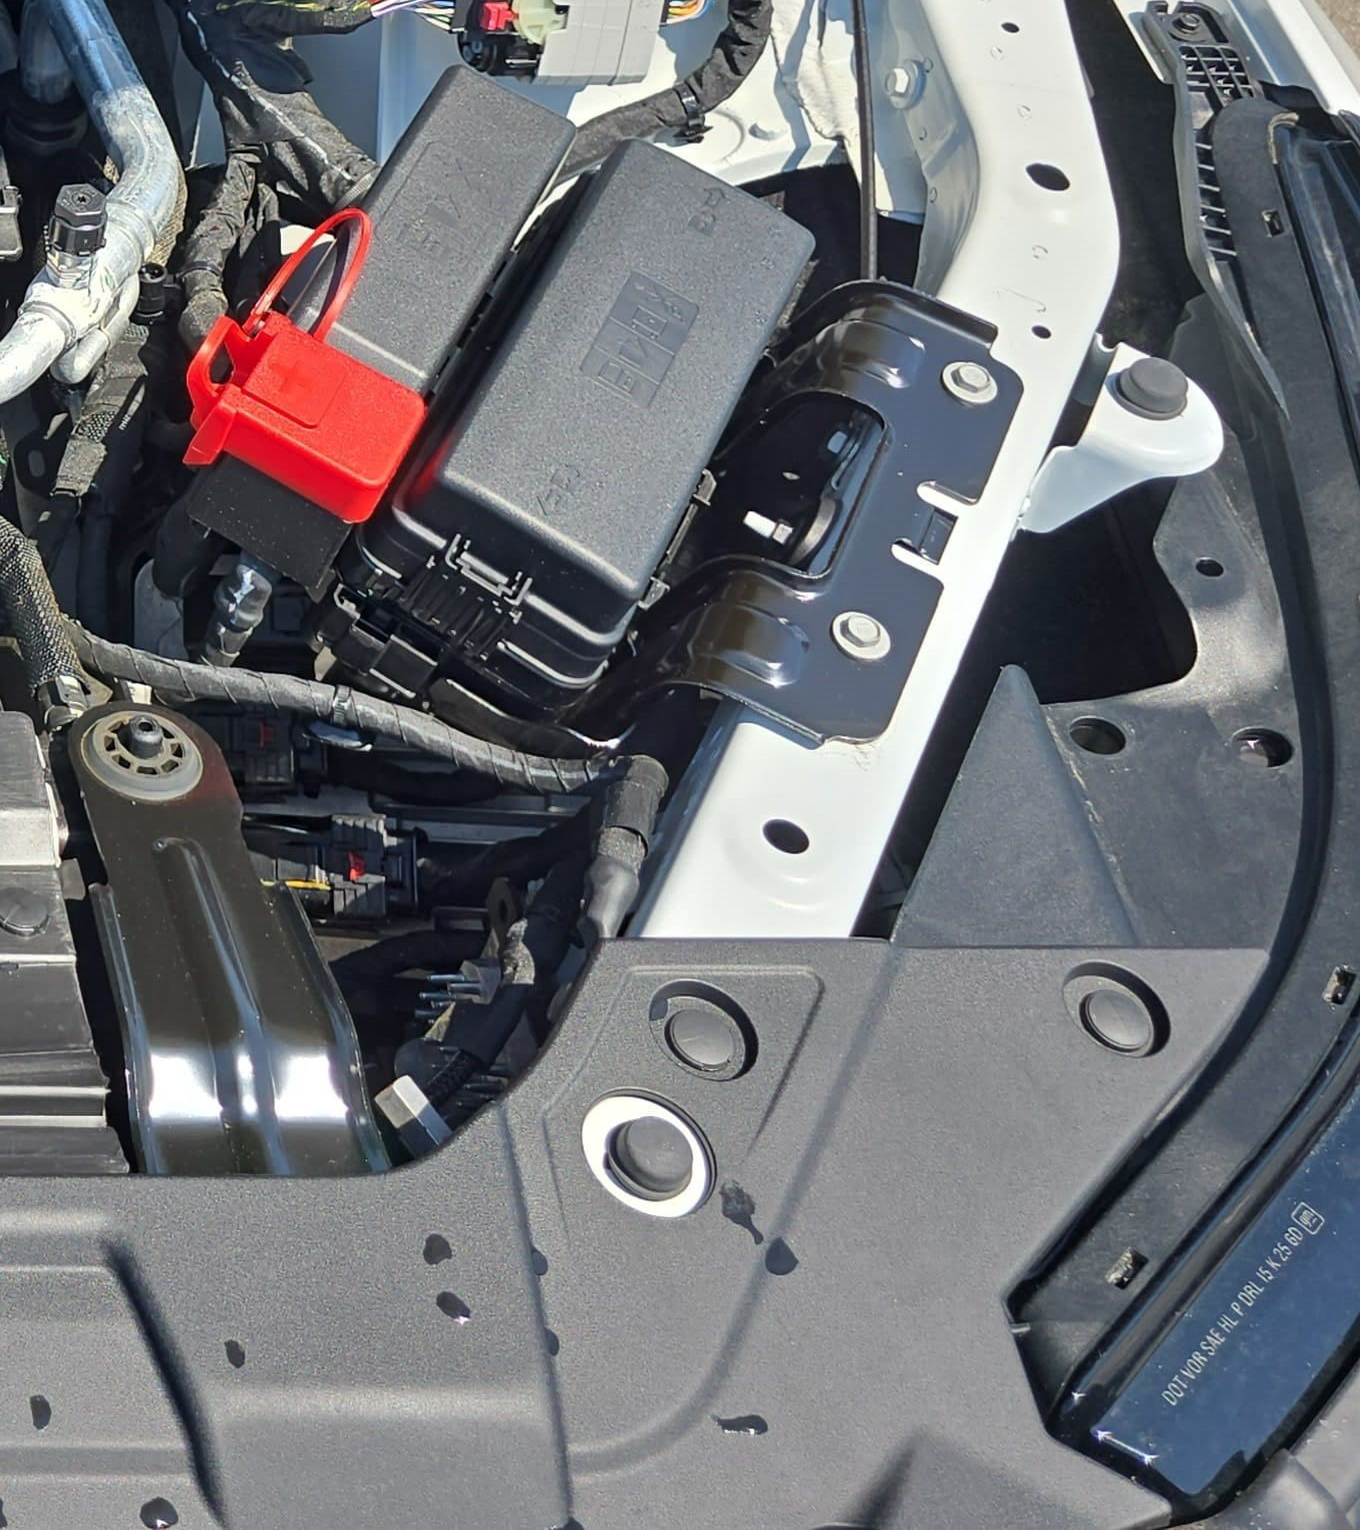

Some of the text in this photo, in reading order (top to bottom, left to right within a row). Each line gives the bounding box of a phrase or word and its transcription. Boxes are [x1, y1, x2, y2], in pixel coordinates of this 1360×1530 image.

[1265, 1255, 1282, 1271] K
[1273, 1243, 1293, 1263] 25
[1238, 1280, 1265, 1307] DRL
[1231, 1301, 1246, 1318] P
[1216, 1313, 1239, 1335] HL
[1199, 1327, 1226, 1357] SAE
[1179, 1350, 1208, 1381] VOR
[1161, 1375, 1189, 1406] DOT
